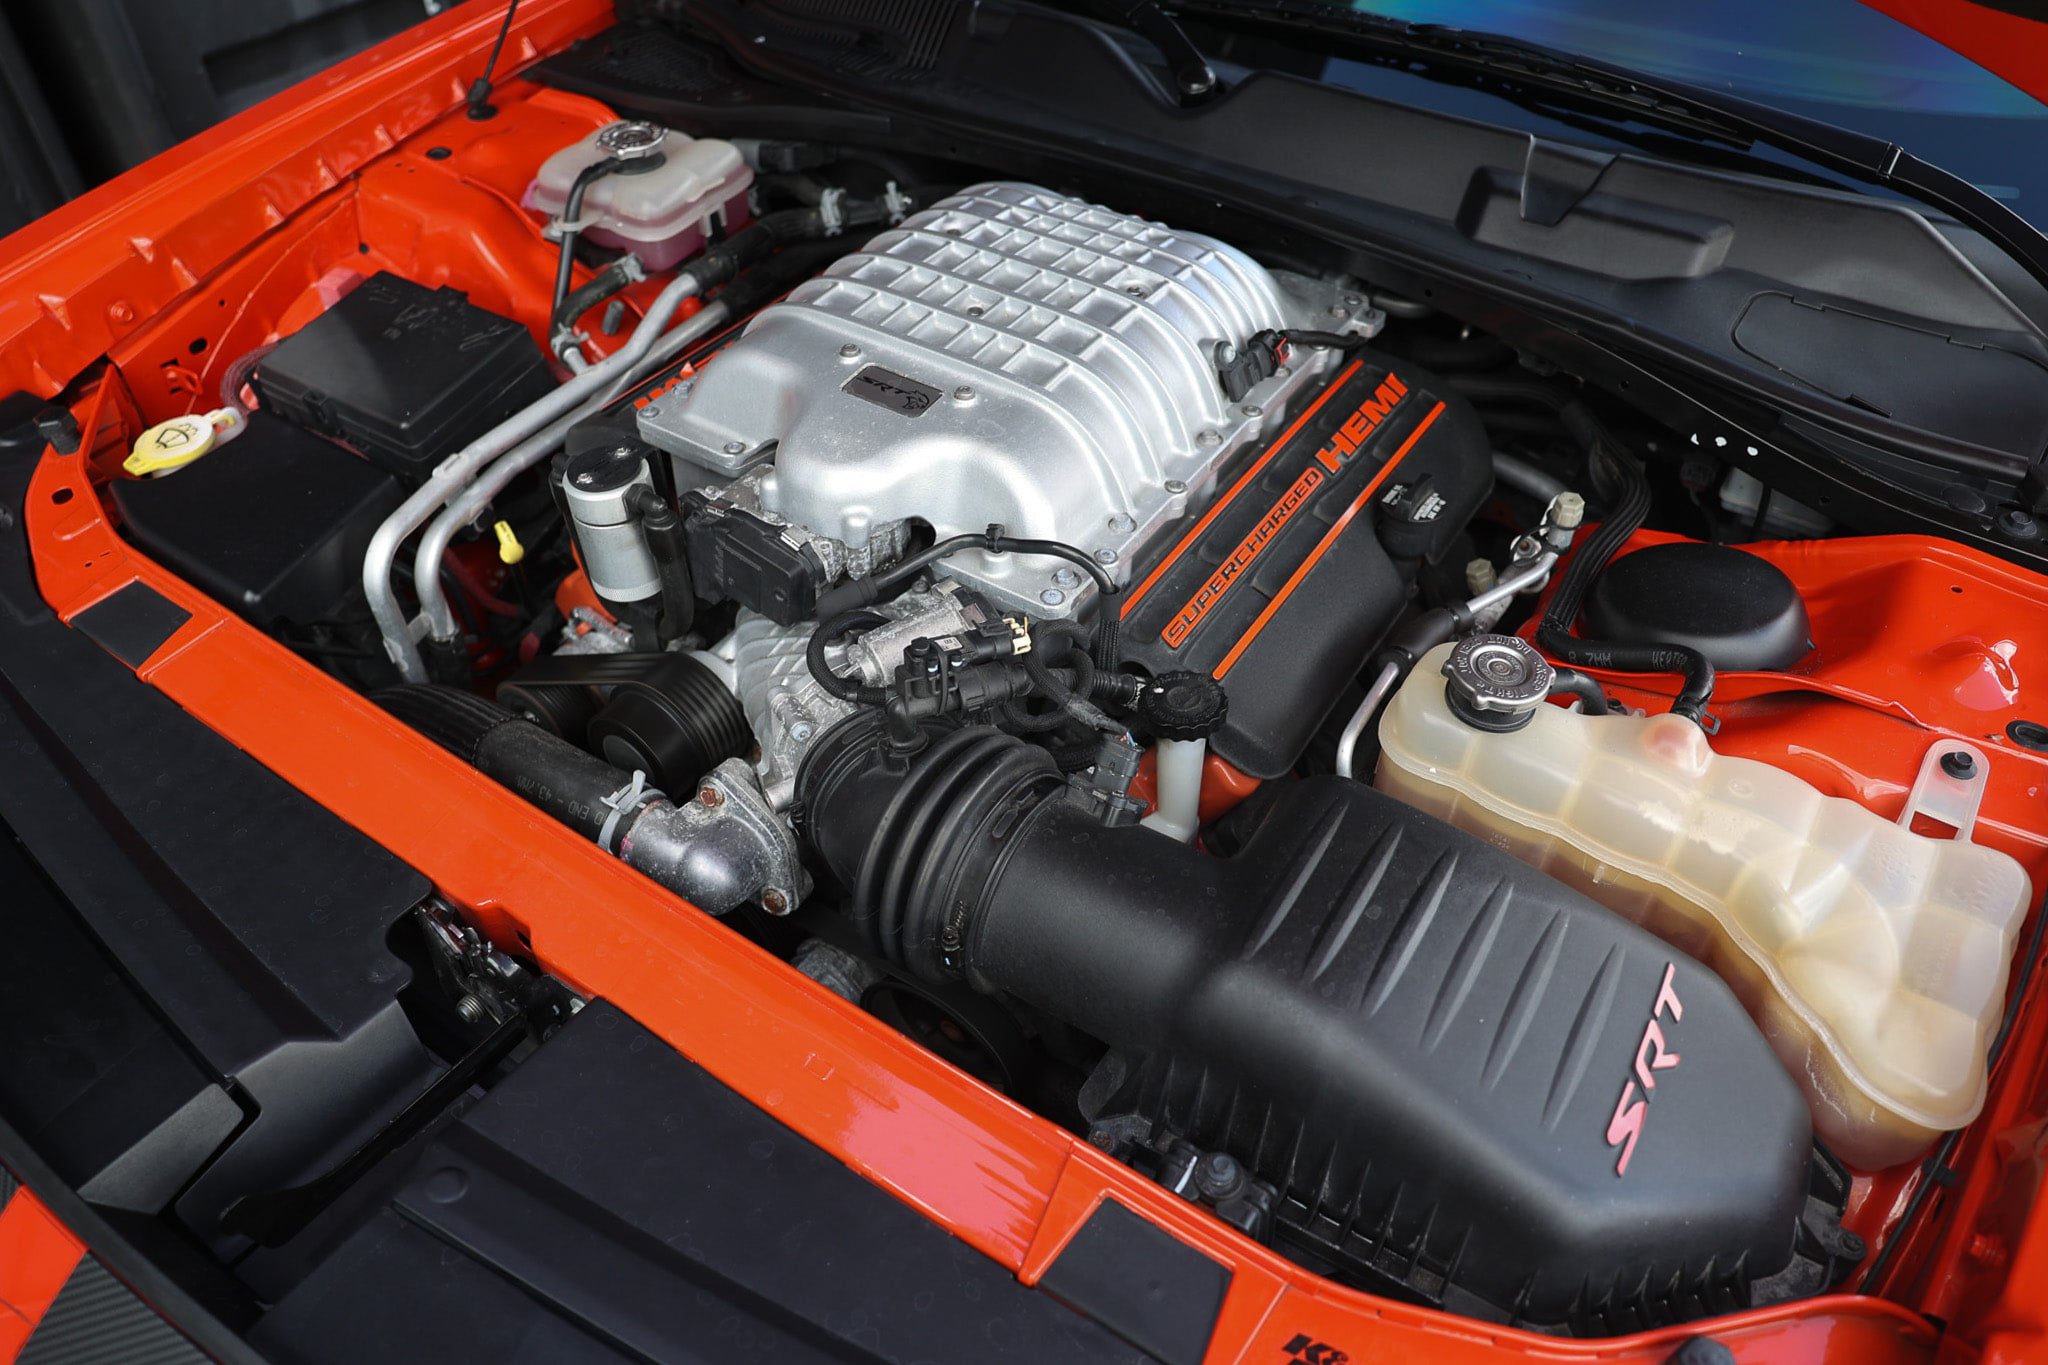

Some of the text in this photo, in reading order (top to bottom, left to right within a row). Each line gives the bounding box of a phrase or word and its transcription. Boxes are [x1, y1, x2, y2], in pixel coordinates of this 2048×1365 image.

[856, 376, 912, 395] SRT
[1164, 467, 1321, 645] SUPERCHARGED
[1315, 373, 1408, 474] HEMI
[1606, 961, 1683, 1178] SRT
